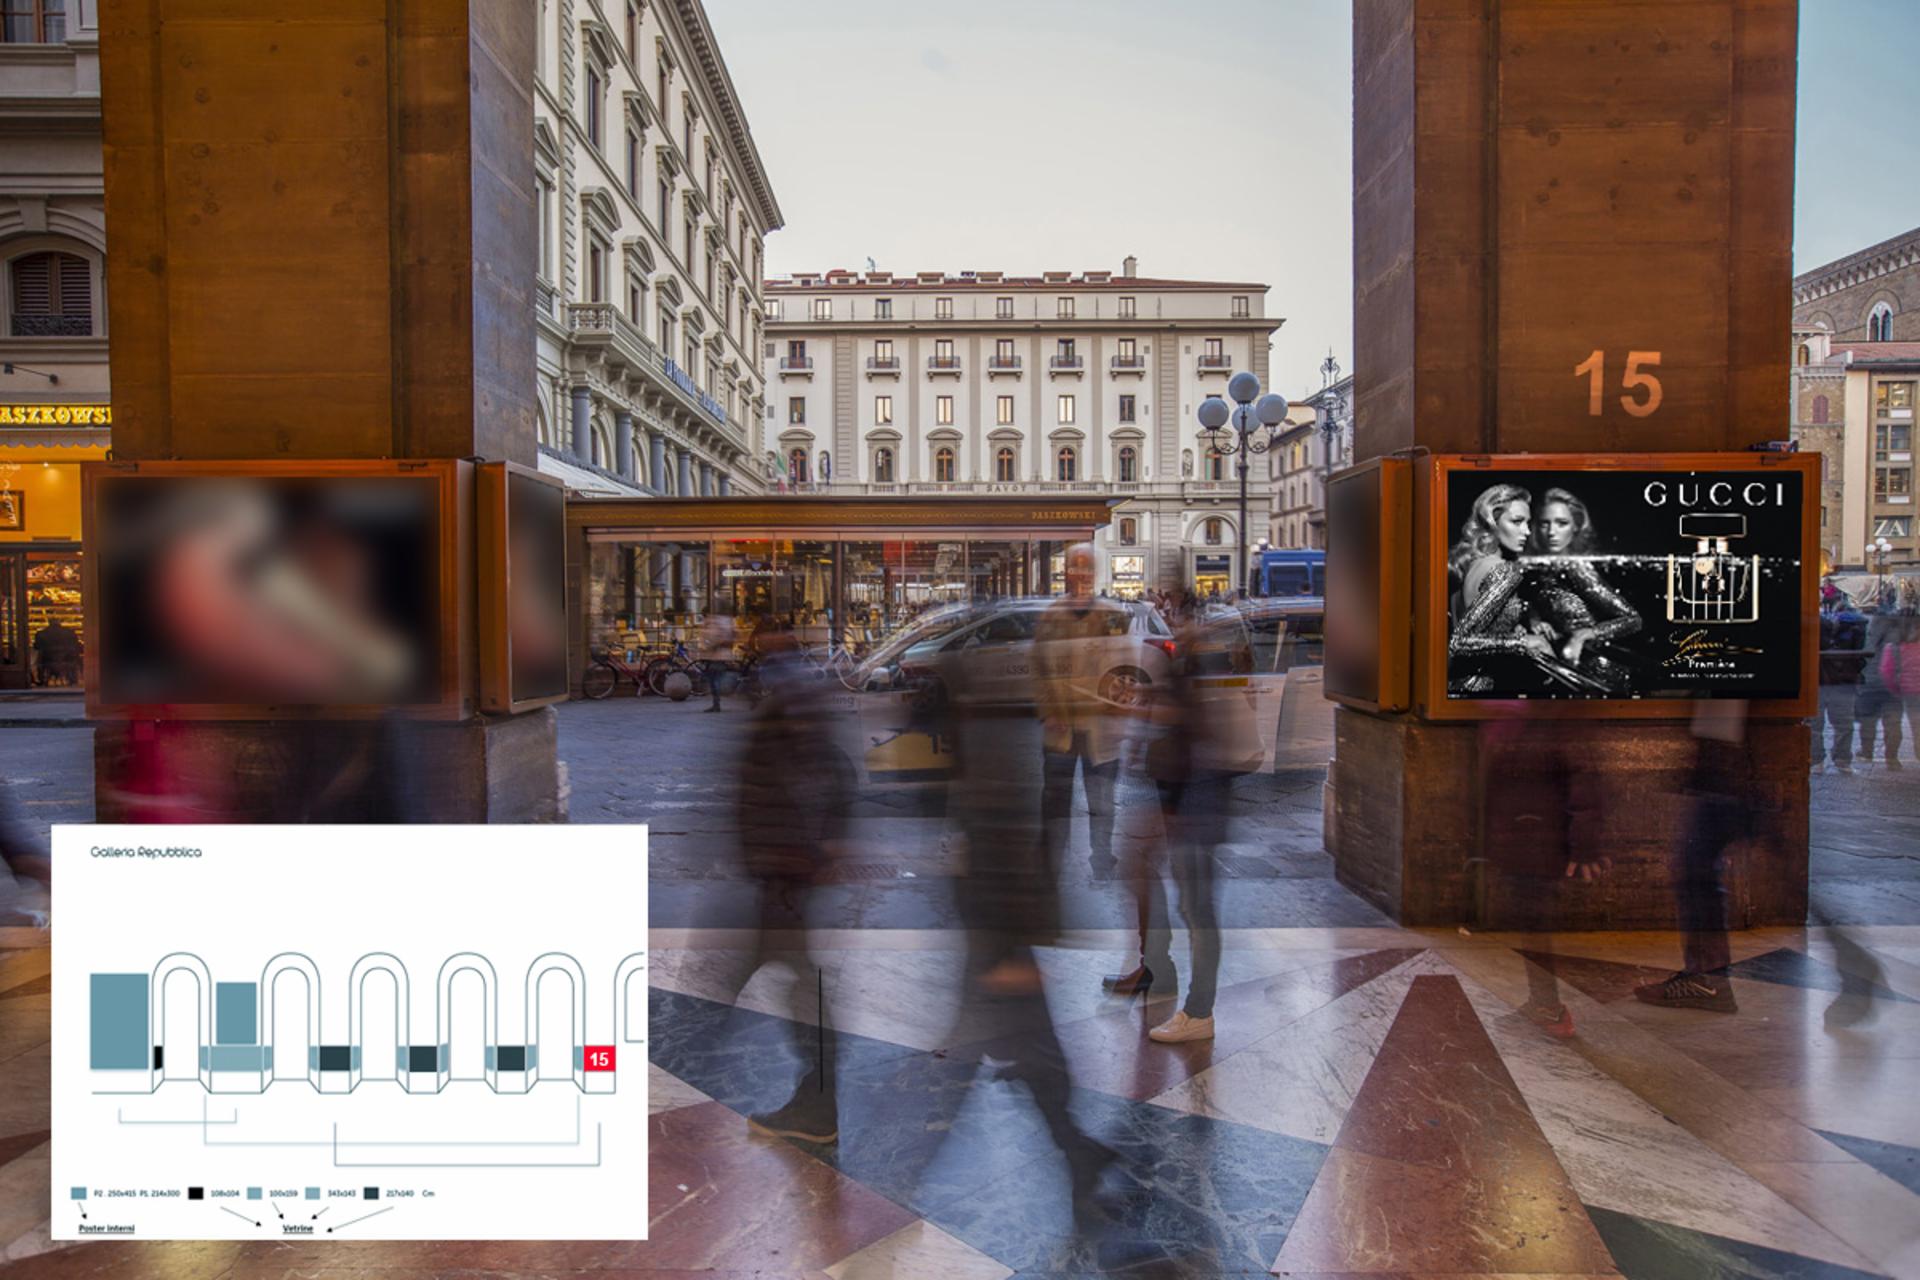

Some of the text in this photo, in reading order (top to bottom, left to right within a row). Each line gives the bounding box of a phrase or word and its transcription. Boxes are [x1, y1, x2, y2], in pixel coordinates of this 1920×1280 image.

[1574, 350, 1663, 417] 15
[986, 483, 1027, 493] SAVOY
[1644, 481, 1784, 507] GUCCI
